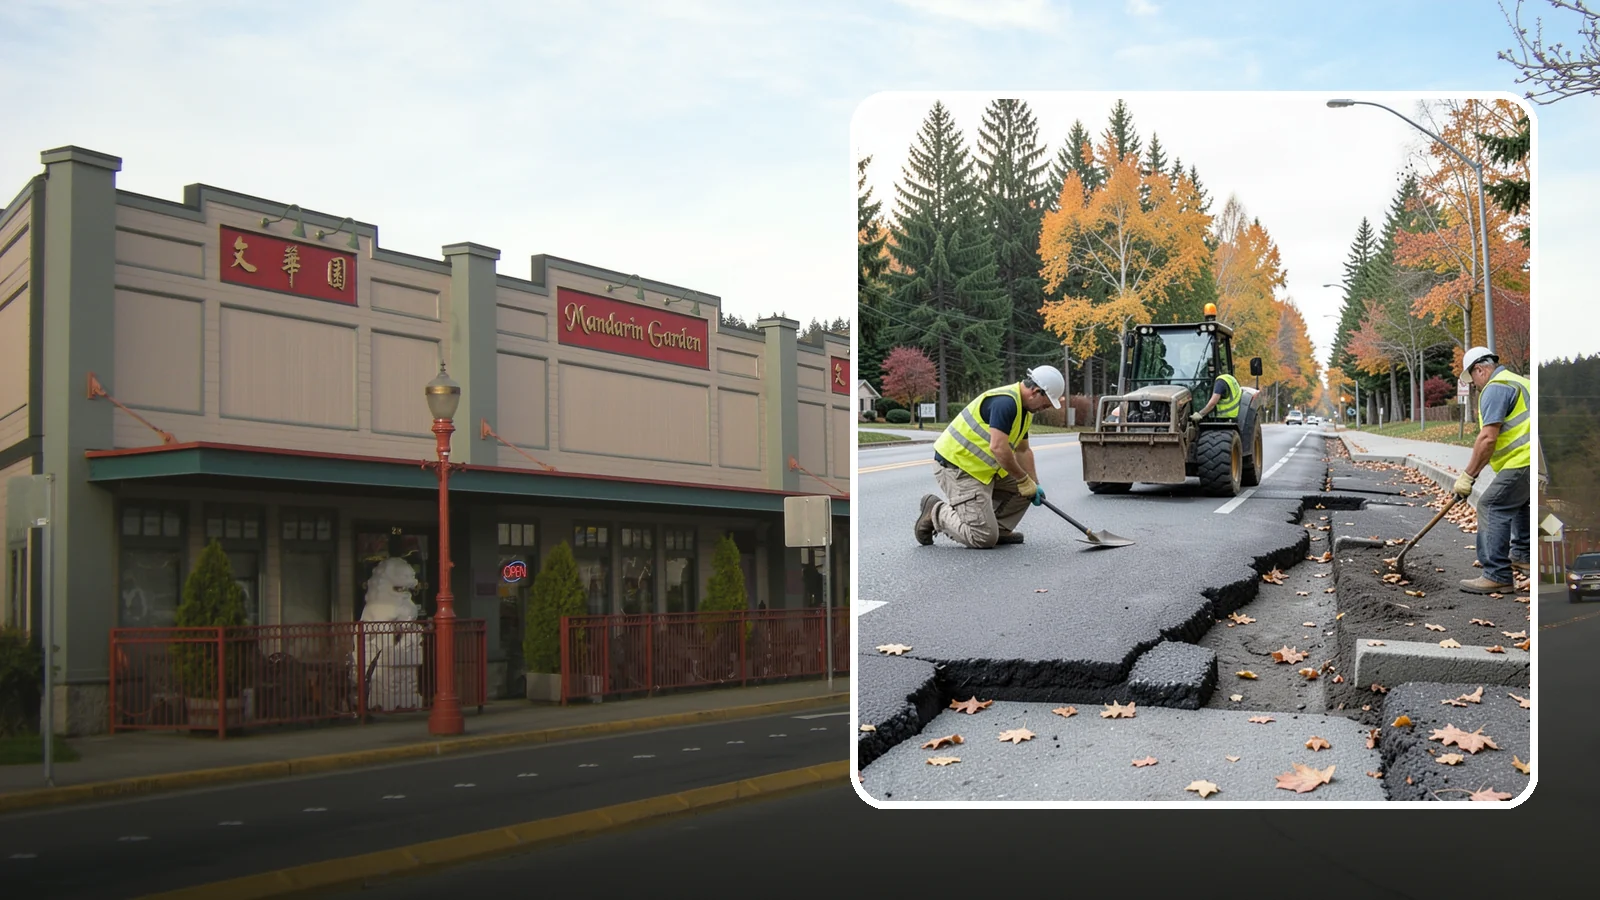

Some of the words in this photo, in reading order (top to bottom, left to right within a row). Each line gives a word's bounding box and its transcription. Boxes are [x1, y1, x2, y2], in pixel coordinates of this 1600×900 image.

[231, 235, 346, 291] 文華園
[564, 302, 644, 341] Mandarin
[647, 320, 702, 352] Garden
[503, 565, 527, 578] OPEN
